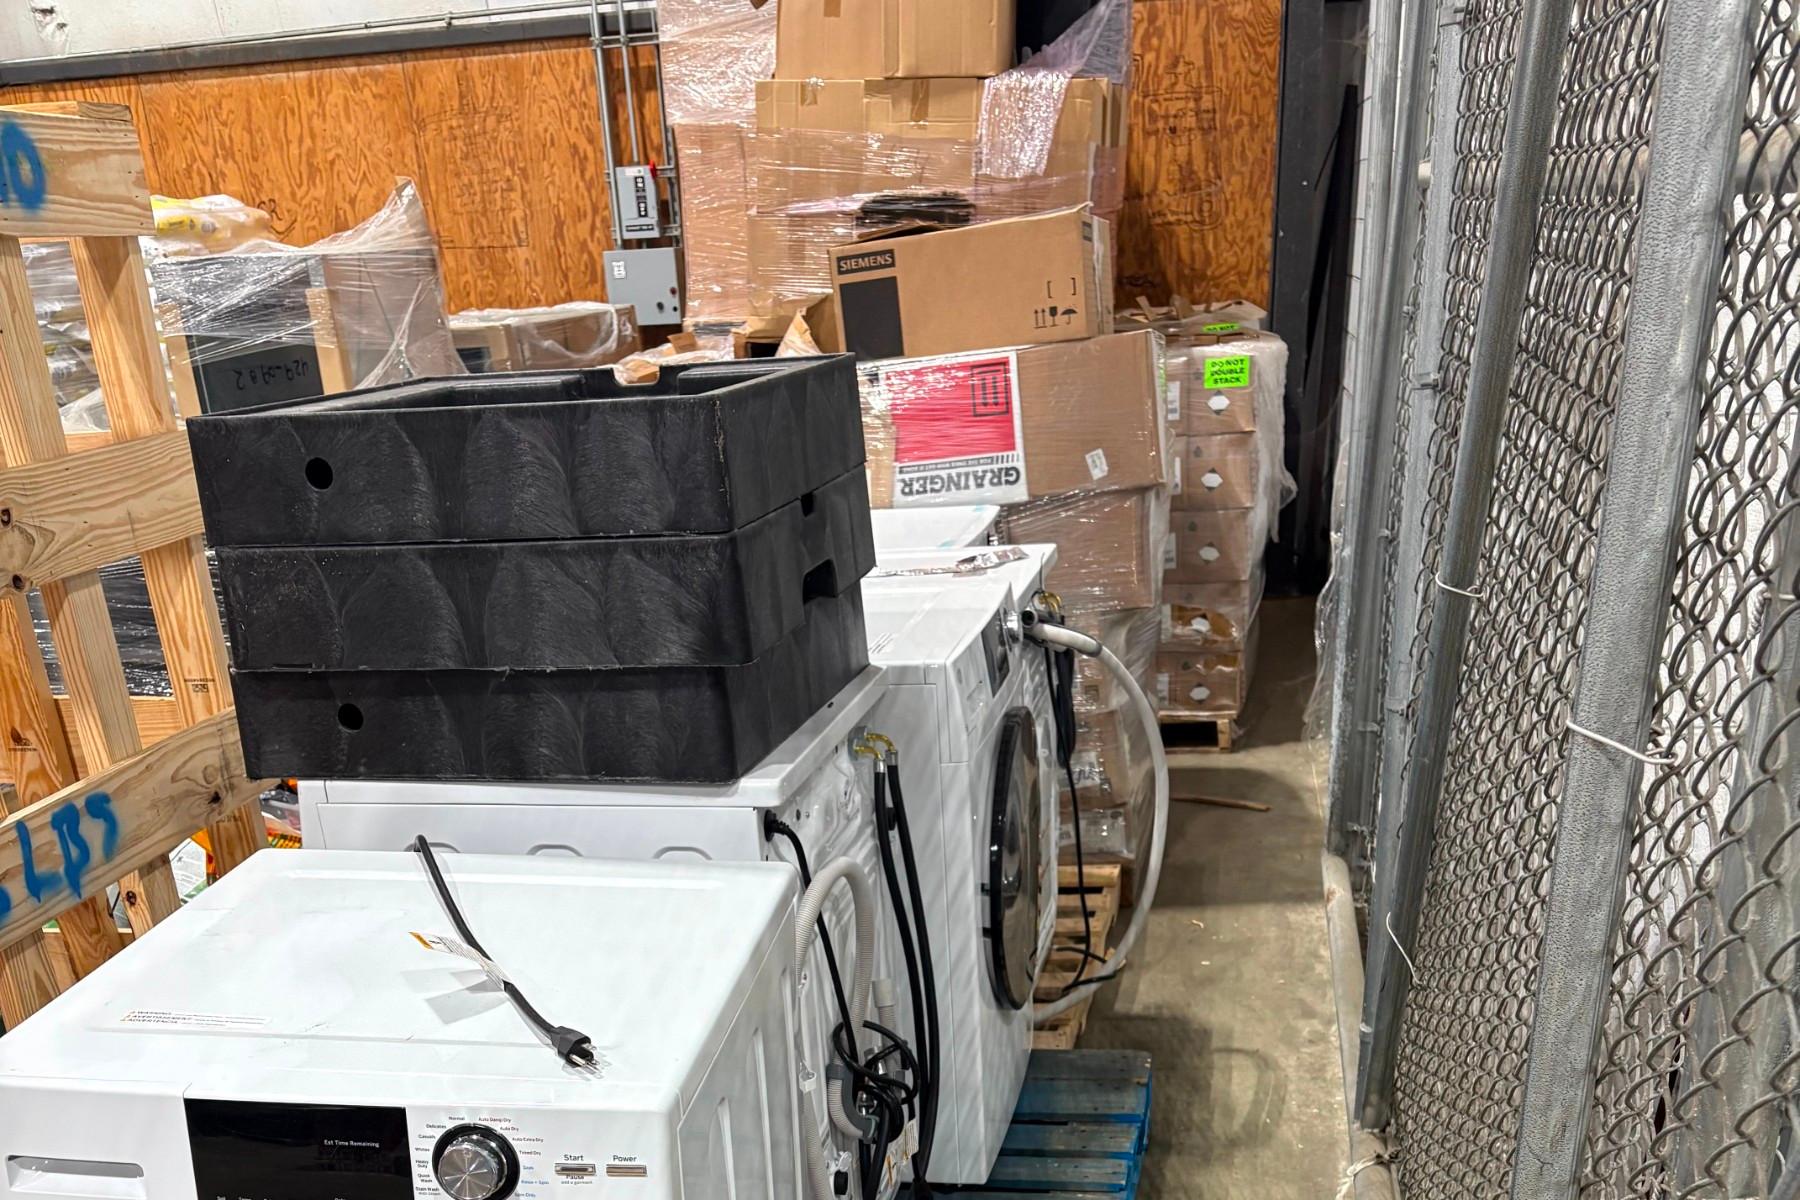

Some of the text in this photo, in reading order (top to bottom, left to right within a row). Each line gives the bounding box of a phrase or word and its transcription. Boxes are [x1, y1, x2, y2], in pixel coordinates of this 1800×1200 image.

[839, 253, 893, 272] SIEMENS
[1225, 358, 1245, 366] NOT
[1210, 367, 1245, 376] DOUBLE
[1213, 376, 1241, 385] STACK
[899, 466, 1021, 497] GRAINGER
[349, 1140, 380, 1148] Remaining
[563, 1154, 584, 1162] Start
[612, 1154, 638, 1162] Power
